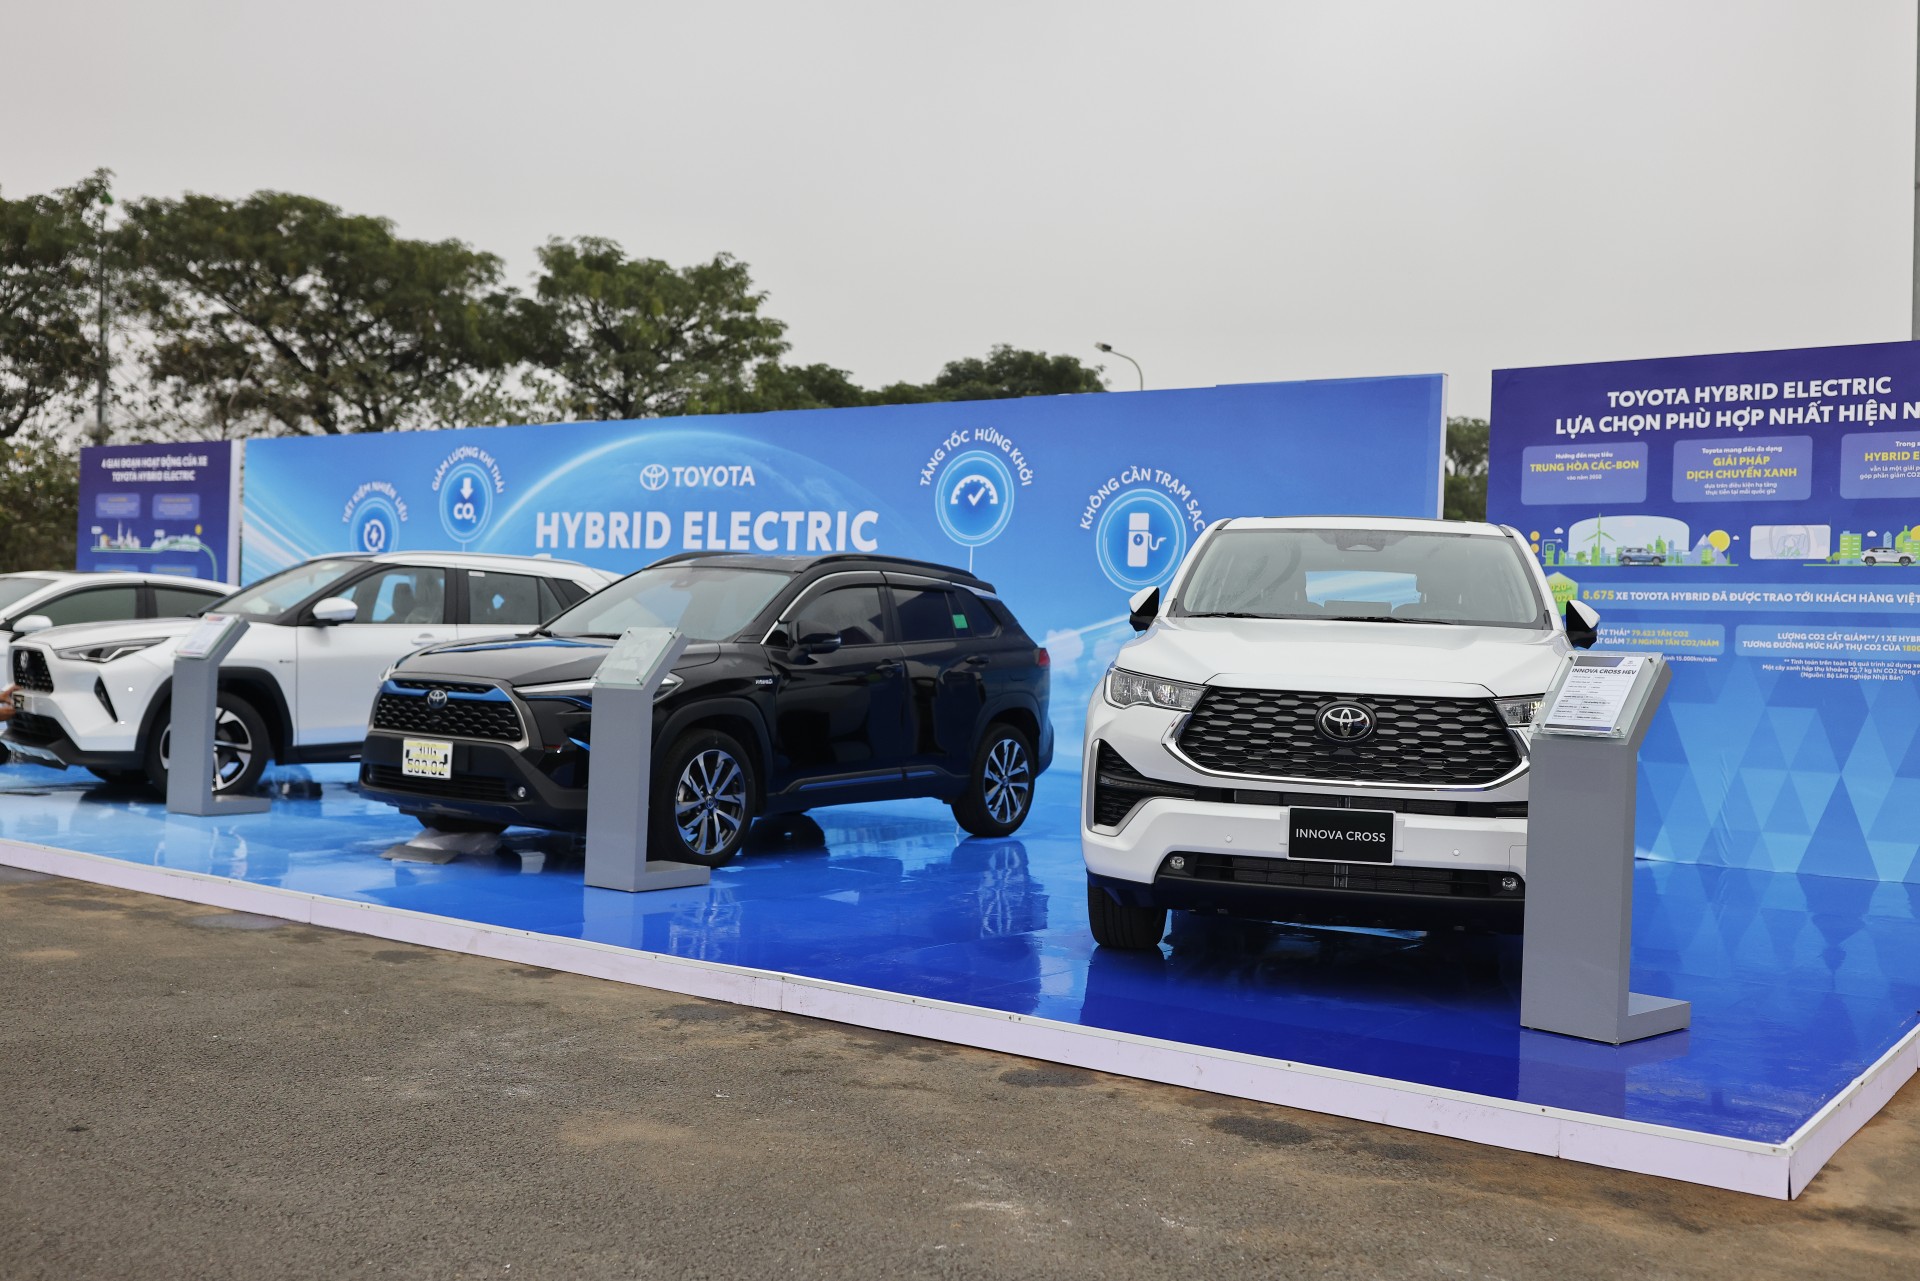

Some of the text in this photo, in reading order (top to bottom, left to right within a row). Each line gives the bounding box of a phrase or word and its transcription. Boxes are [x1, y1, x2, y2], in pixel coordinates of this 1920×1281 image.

[1607, 376, 1892, 408] TOYOTA HYBRID ELECTRIC
[1555, 415, 1595, 439] LỰA
[1598, 413, 1661, 436] CHỌN
[1665, 407, 1711, 430] PHÙ
[1715, 406, 1765, 431] HỢP
[1769, 400, 1834, 426] NHẤT
[1838, 399, 1897, 427] HIỆN
[920, 448, 946, 486] TĂNG
[943, 430, 970, 451] TỐC
[975, 427, 1012, 453] HỨNG
[1713, 454, 1771, 466] GIẢI PHÁP
[1864, 451, 1911, 462] HYBRID
[1530, 462, 1564, 472] TRUNG
[1566, 460, 1589, 471] HÒA
[672, 465, 756, 488] TOYOTA
[1686, 470, 1713, 481] DỊCH
[1764, 467, 1797, 477] XANH
[1080, 465, 1206, 532] KHÔNG CẦN TRẠM SẠC
[535, 510, 880, 552] HYBRID ELECTRIC
[1582, 590, 1615, 600] 8.675
[1616, 592, 1628, 600] XE
[1630, 592, 1669, 601] TOYOTA
[1671, 592, 1710, 601] HYBRID
[1711, 590, 1728, 601] ĐÃ
[1729, 592, 1762, 604] ĐƯỢC
[1762, 592, 1793, 602] TRAO
[1795, 591, 1814, 602] TỚI
[1816, 591, 1858, 603] KHÁCH
[1860, 592, 1894, 603] HÀNG
[1808, 633, 1825, 641] CO2
[1845, 643, 1863, 652] THỤ
[1295, 828, 1386, 842] INNOVA CROSS
